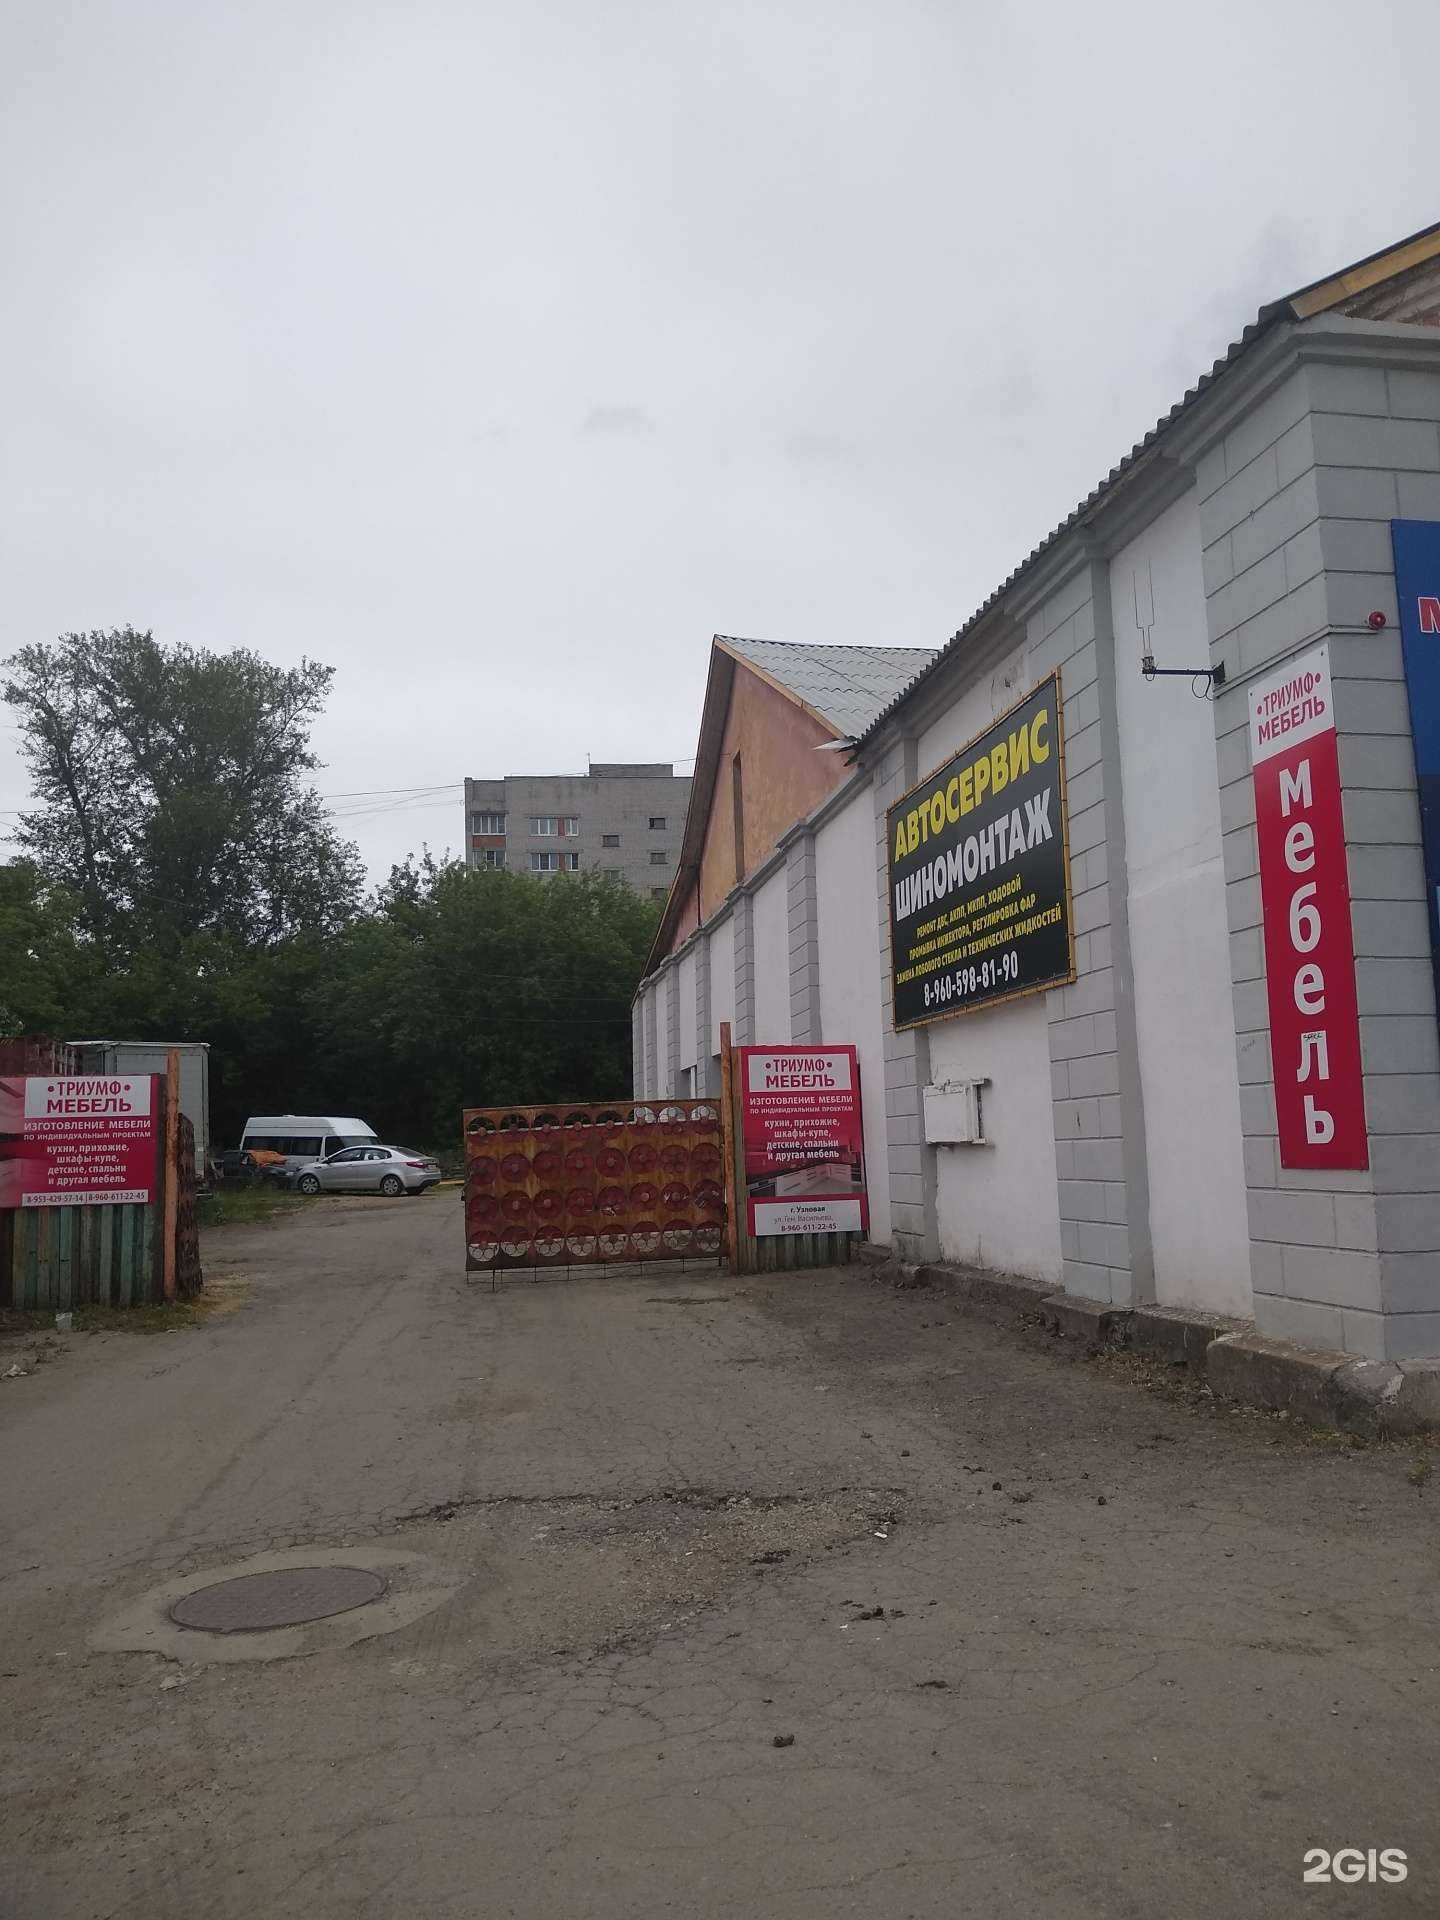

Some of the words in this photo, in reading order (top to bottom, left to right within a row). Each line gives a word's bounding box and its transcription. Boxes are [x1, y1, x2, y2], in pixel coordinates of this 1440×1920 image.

[1263, 671, 1314, 716] ТРИУМФ
[1257, 695, 1325, 745] МЕБЕЛЬ
[894, 709, 1051, 863] АВТОСЕРВИС
[895, 787, 1053, 922] ШИНОМОНТАЖ
[917, 917, 936, 938] РЕМОНТ
[987, 873, 1022, 904] ХОДОВОЙ
[909, 940, 937, 960] ПРОМЫВКА
[972, 901, 1019, 932] РЕГУЛИРОВКА
[1019, 893, 1036, 912] ФАР
[914, 956, 942, 977] ЛОБОВОГО
[941, 948, 963, 966] СТЕКЛА
[968, 925, 1014, 956] ТЕХНИЧЕСКИХ
[1014, 902, 1063, 936] ЖИДКОСТЕЙ
[924, 951, 1018, 1006] 8-960-598-81-90
[773, 1059, 825, 1073] ТРИУМФ
[57, 1080, 121, 1096] ТРИУМФ
[766, 1074, 835, 1089] МЕБЕЛЬ
[47, 1098, 132, 1113] МЕБЕЛЬ
[749, 1096, 816, 1106] ИЗГОТОВЛЕНИЕ
[818, 1095, 853, 1104] МЕБЕЛИ
[761, 1106, 820, 1114] ИНДИВИДУАЛЬНЫМ
[24, 1121, 105, 1131] ИЗГОТОВЛЕНИЕ
[108, 1119, 151, 1129] МЕБЕЛИ
[764, 1119, 793, 1129] кухни,
[794, 1118, 841, 1129] прихожие,
[23, 1133, 35, 1141] ПО
[37, 1132, 110, 1141] ИНДИВИДУАЛЬНЫМ
[774, 1129, 831, 1139] шкафы-купе,
[47, 1145, 77, 1154] кухни,
[79, 1144, 130, 1154] прихожие,
[766, 1141, 803, 1151] детские,
[803, 1139, 840, 1148] спальни
[57, 1155, 119, 1165] шкафы-купе,
[775, 1151, 805, 1162] другая
[806, 1149, 840, 1159] мебель
[47, 1165, 87, 1175] детские,
[88, 1164, 127, 1173] спальни
[57, 1177, 89, 1186] другая
[90, 1174, 126, 1184] мебель
